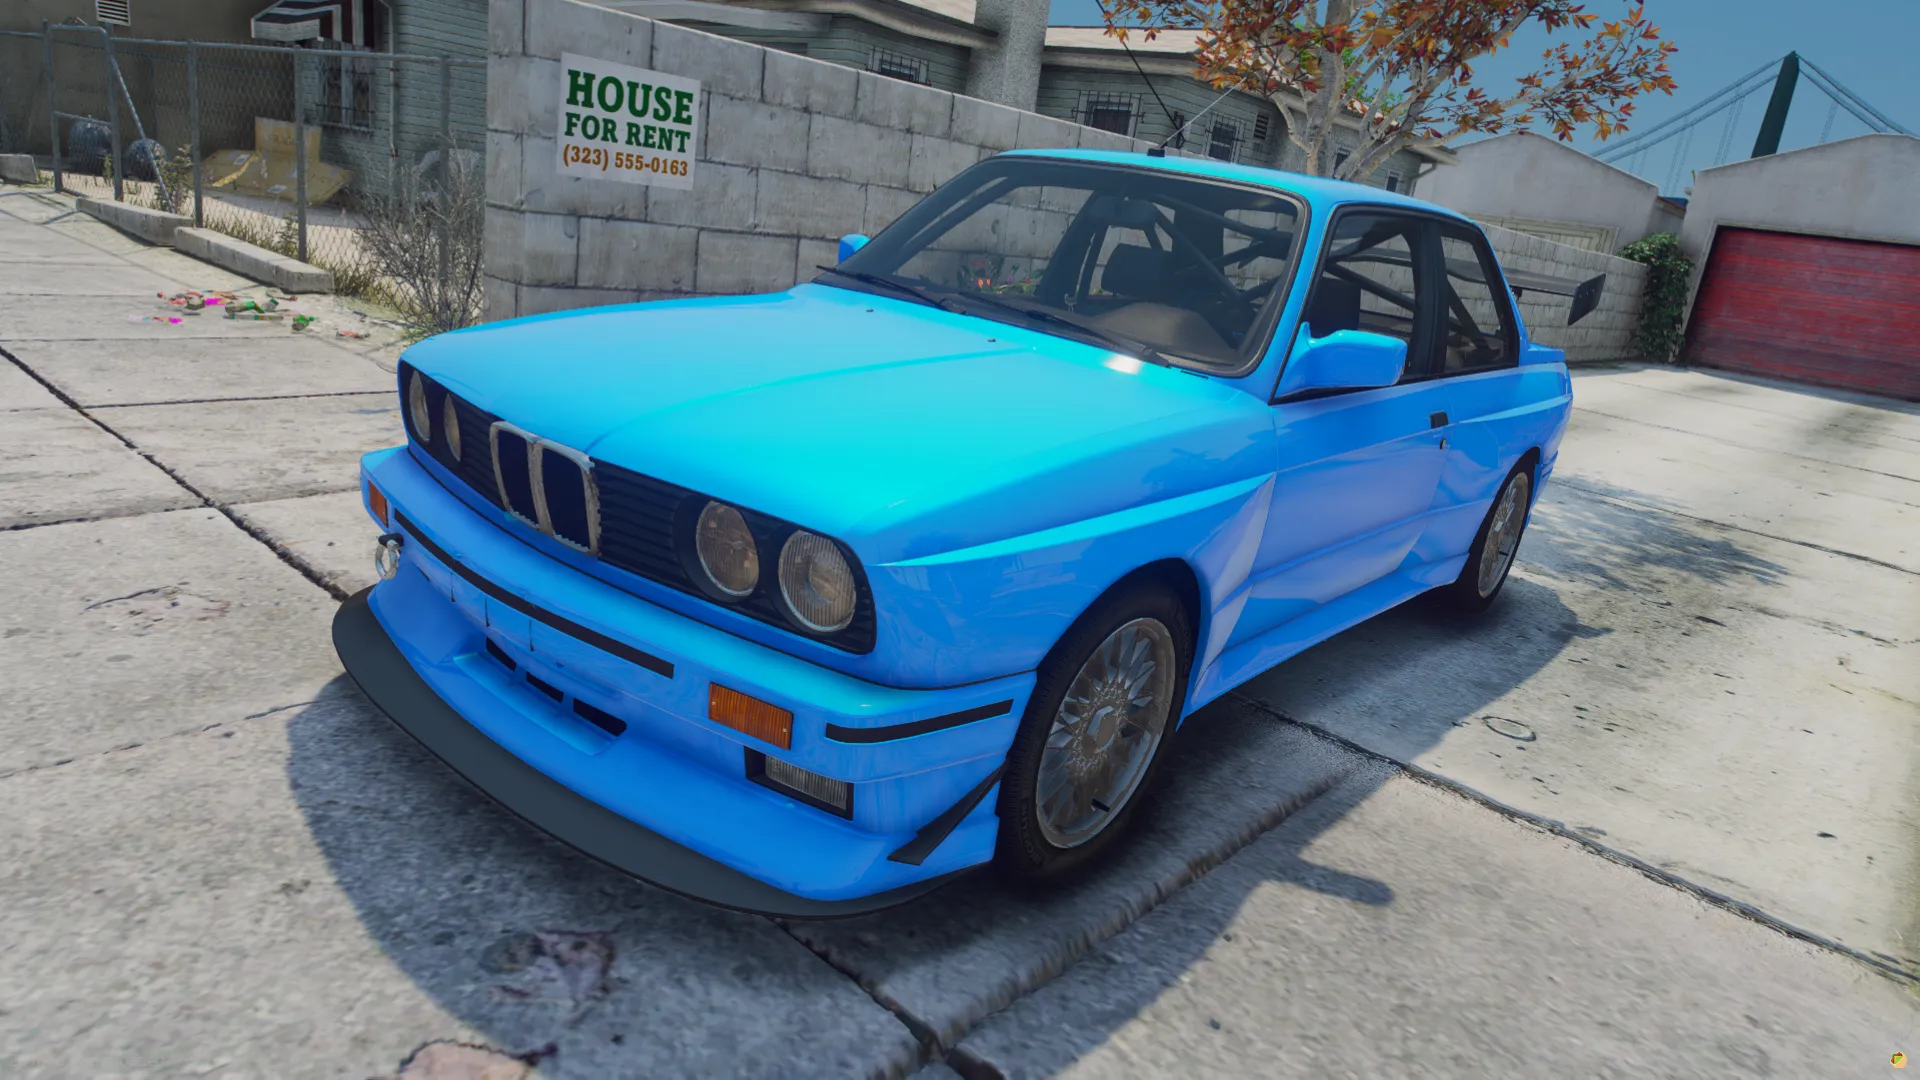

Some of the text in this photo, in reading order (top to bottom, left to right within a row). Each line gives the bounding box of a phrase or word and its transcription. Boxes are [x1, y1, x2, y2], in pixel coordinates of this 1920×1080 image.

[566, 69, 694, 125] HOUSE
[564, 112, 691, 153] FOR RENT
[563, 143, 688, 177] (323) 555-0163
